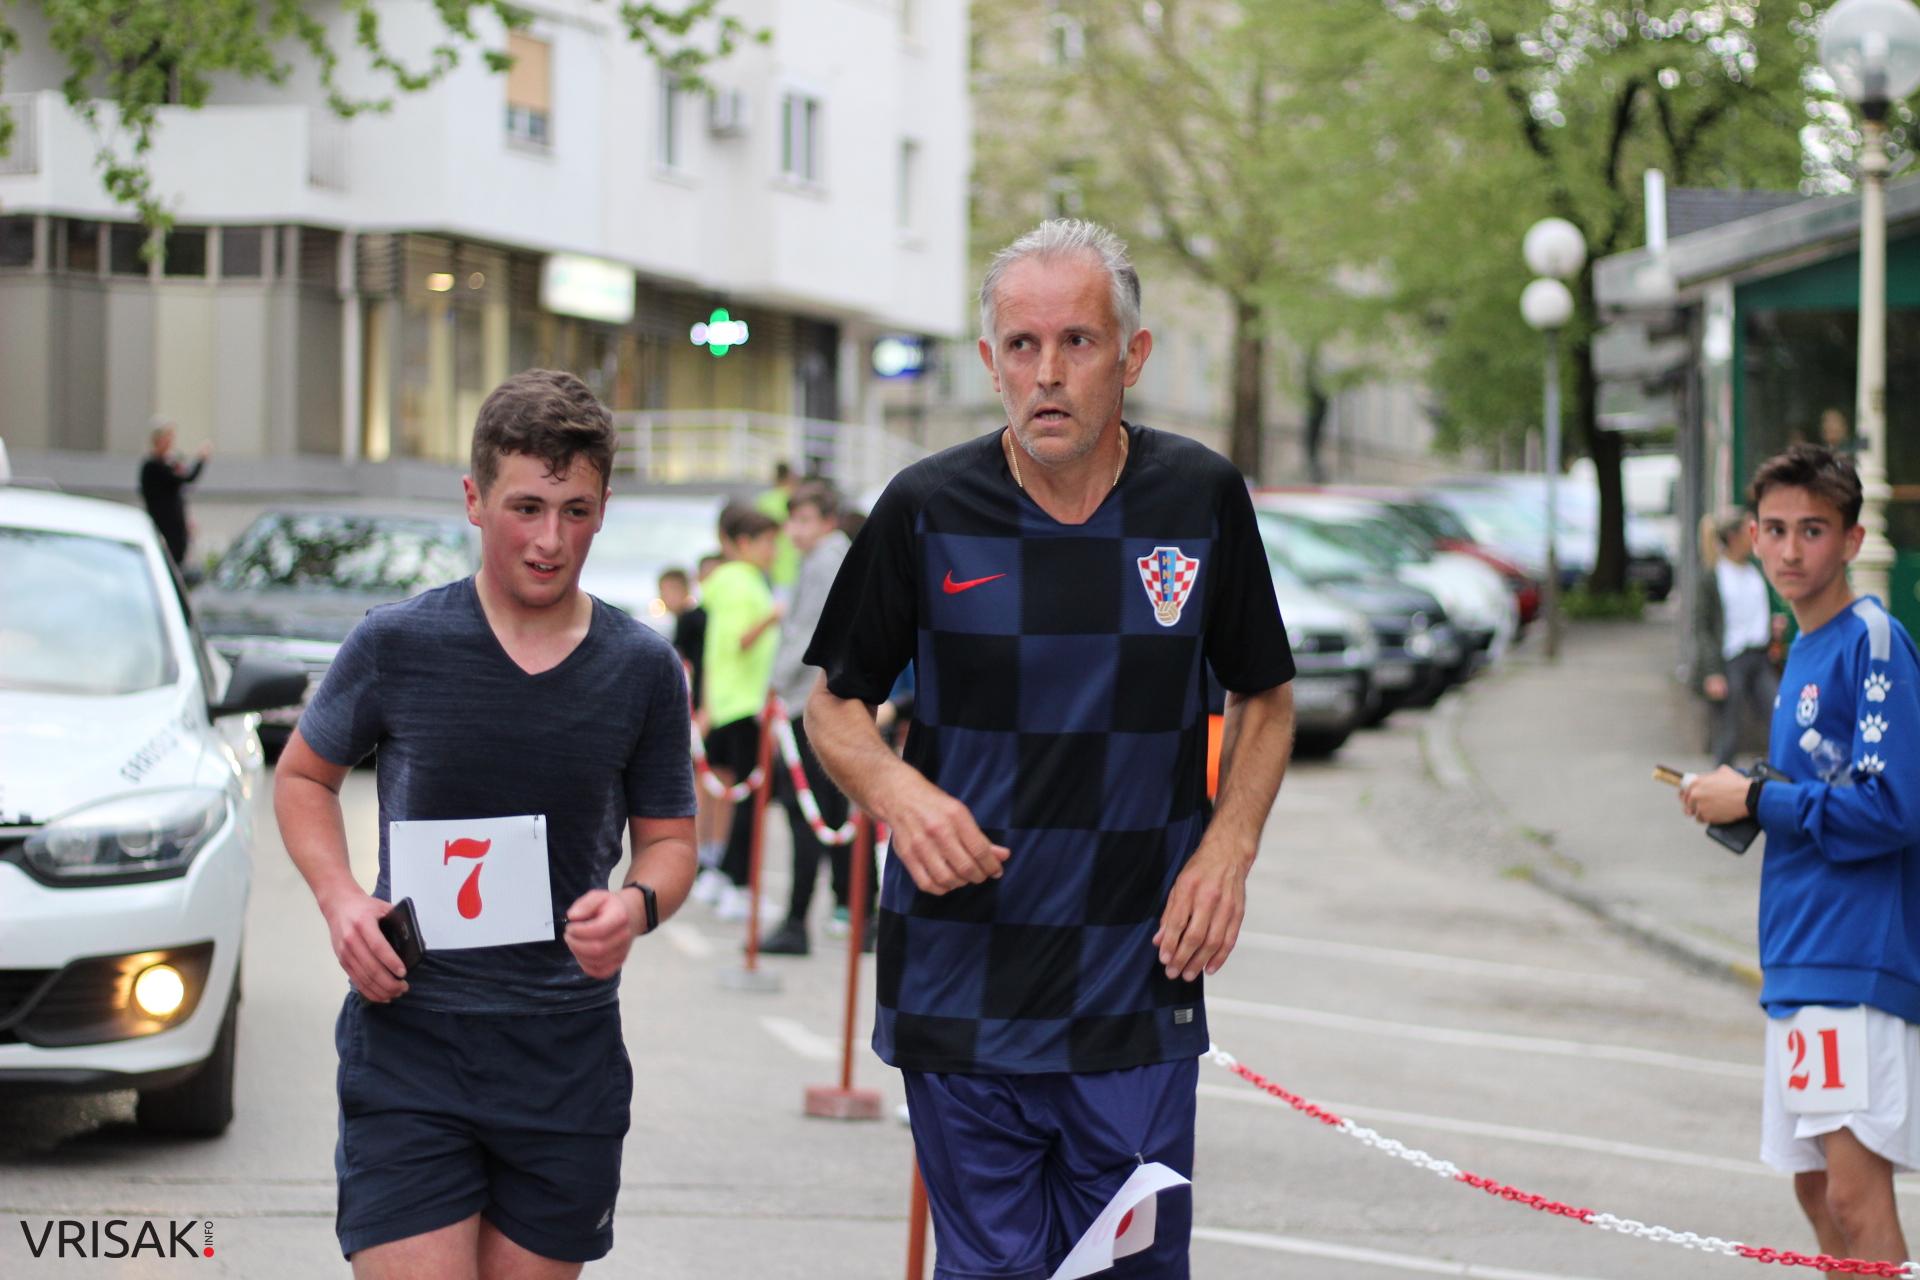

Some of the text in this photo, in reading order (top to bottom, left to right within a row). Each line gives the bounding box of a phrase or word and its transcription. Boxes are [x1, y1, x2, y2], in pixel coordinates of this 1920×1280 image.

[1162, 555, 1172, 594] HNS
[442, 837, 491, 920] 7
[1787, 1028, 1846, 1091] 21
